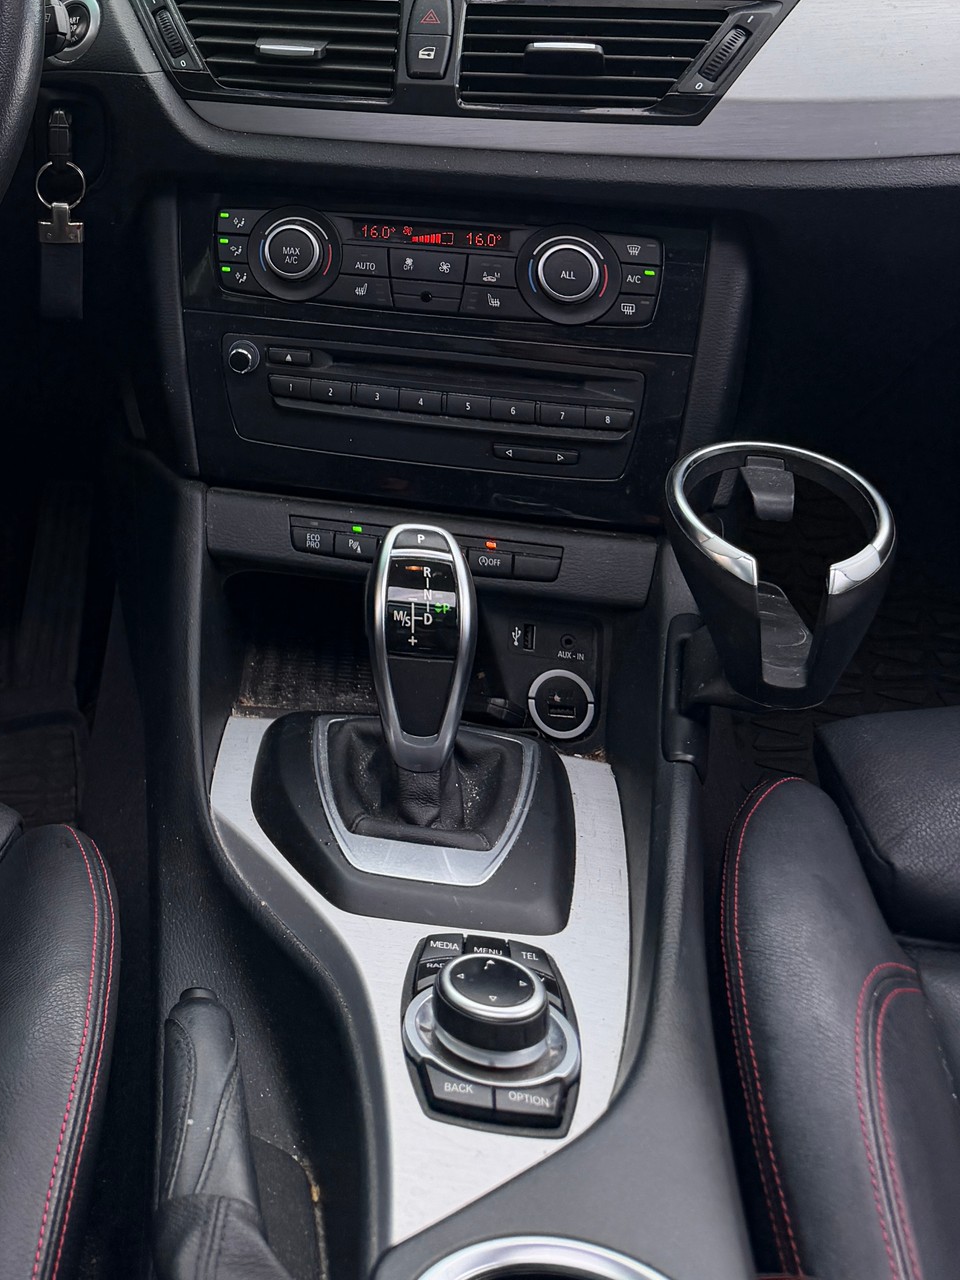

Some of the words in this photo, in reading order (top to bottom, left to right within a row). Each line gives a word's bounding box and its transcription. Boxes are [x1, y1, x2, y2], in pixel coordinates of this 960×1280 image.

[282, 246, 301, 256] MAX
[284, 256, 298, 264] A/C
[354, 261, 376, 271] AUTO
[560, 270, 576, 280] ALL
[626, 274, 641, 284] A/C
[289, 383, 293, 392] 1
[328, 388, 333, 397] 2
[375, 392, 380, 401] 3
[418, 397, 424, 406] 4
[466, 402, 471, 411] 5
[510, 406, 516, 415] 6
[560, 411, 565, 420] 7
[605, 415, 611, 424] 8
[306, 533, 321, 541] ECO
[417, 534, 425, 544] P
[306, 540, 320, 549] PRO
[488, 558, 501, 567] OFF
[423, 566, 431, 578] R
[423, 589, 432, 600] N
[393, 610, 411, 627] M/S
[423, 613, 433, 625] D
[429, 940, 460, 952] MEDIA
[473, 946, 503, 956] MENU
[521, 951, 539, 961] TEL
[444, 1082, 474, 1094] BACK
[508, 1090, 551, 1108] OPTION
